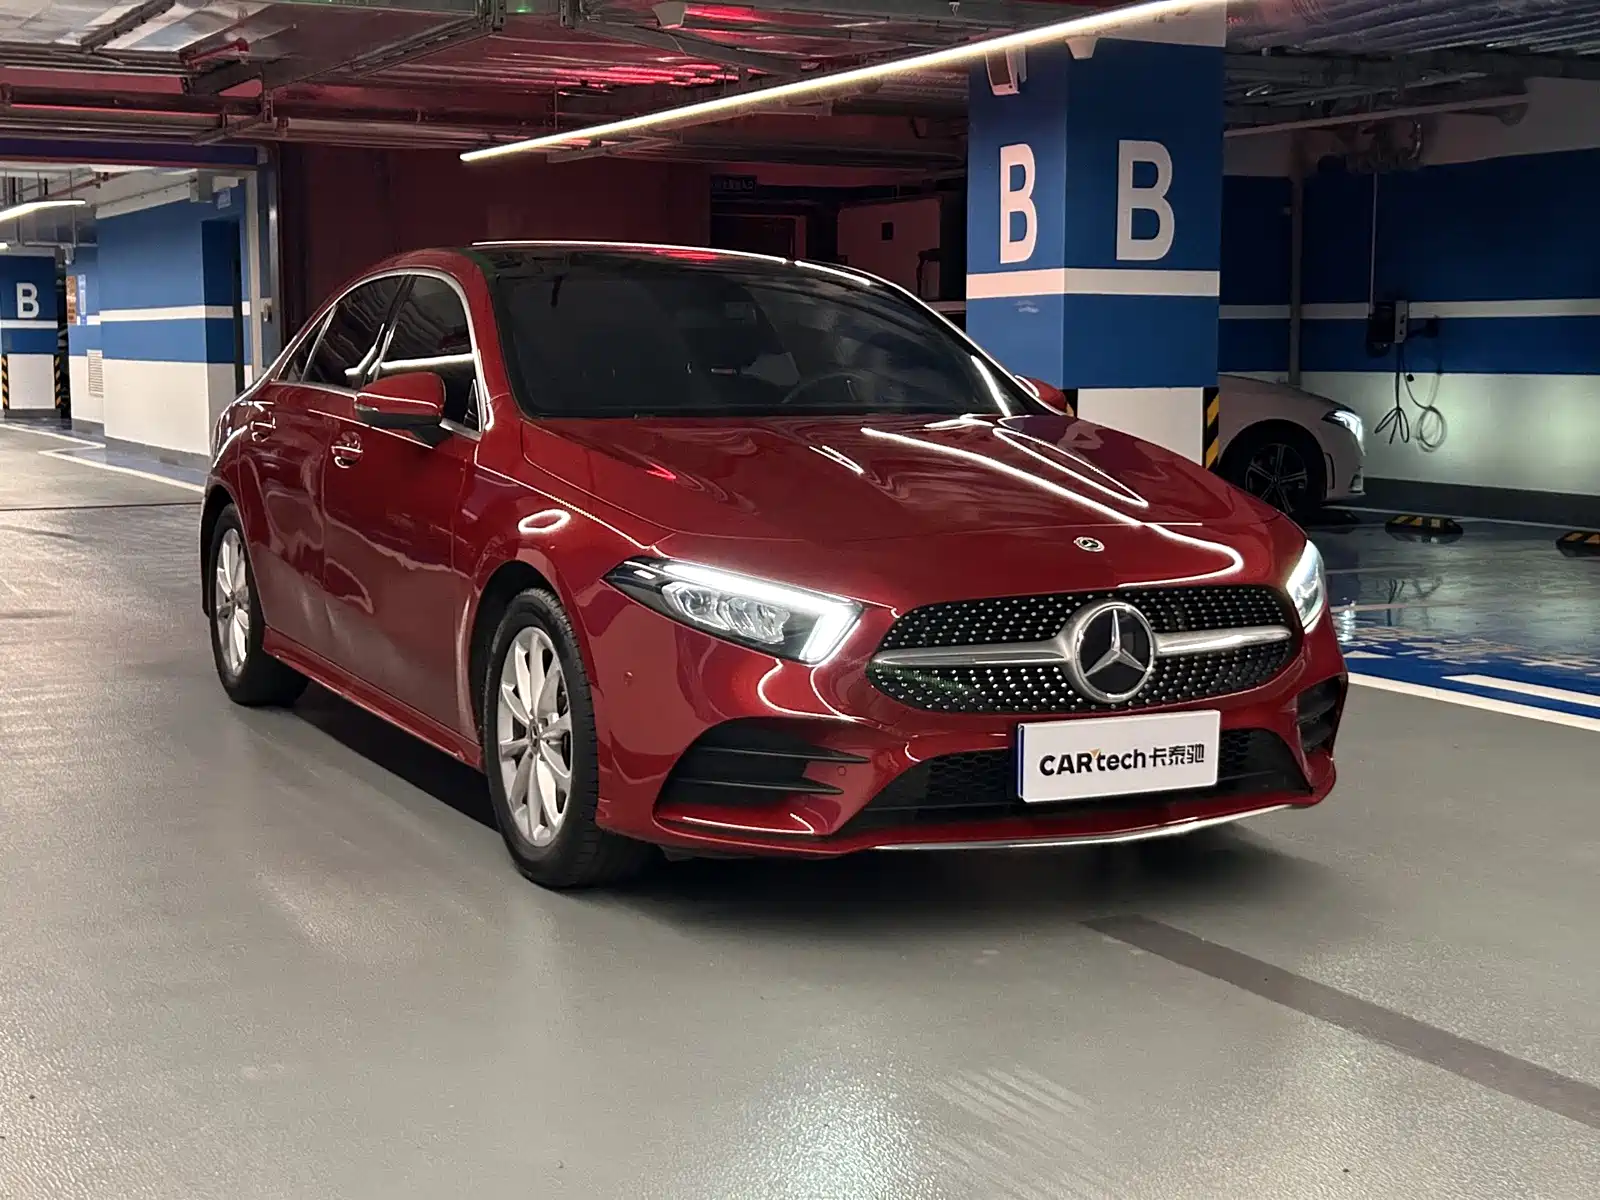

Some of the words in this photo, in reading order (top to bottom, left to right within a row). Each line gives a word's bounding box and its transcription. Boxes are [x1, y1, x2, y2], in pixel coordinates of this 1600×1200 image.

[1000, 143, 1038, 264] B
[1116, 139, 1175, 261] B
[16, 282, 40, 319] B
